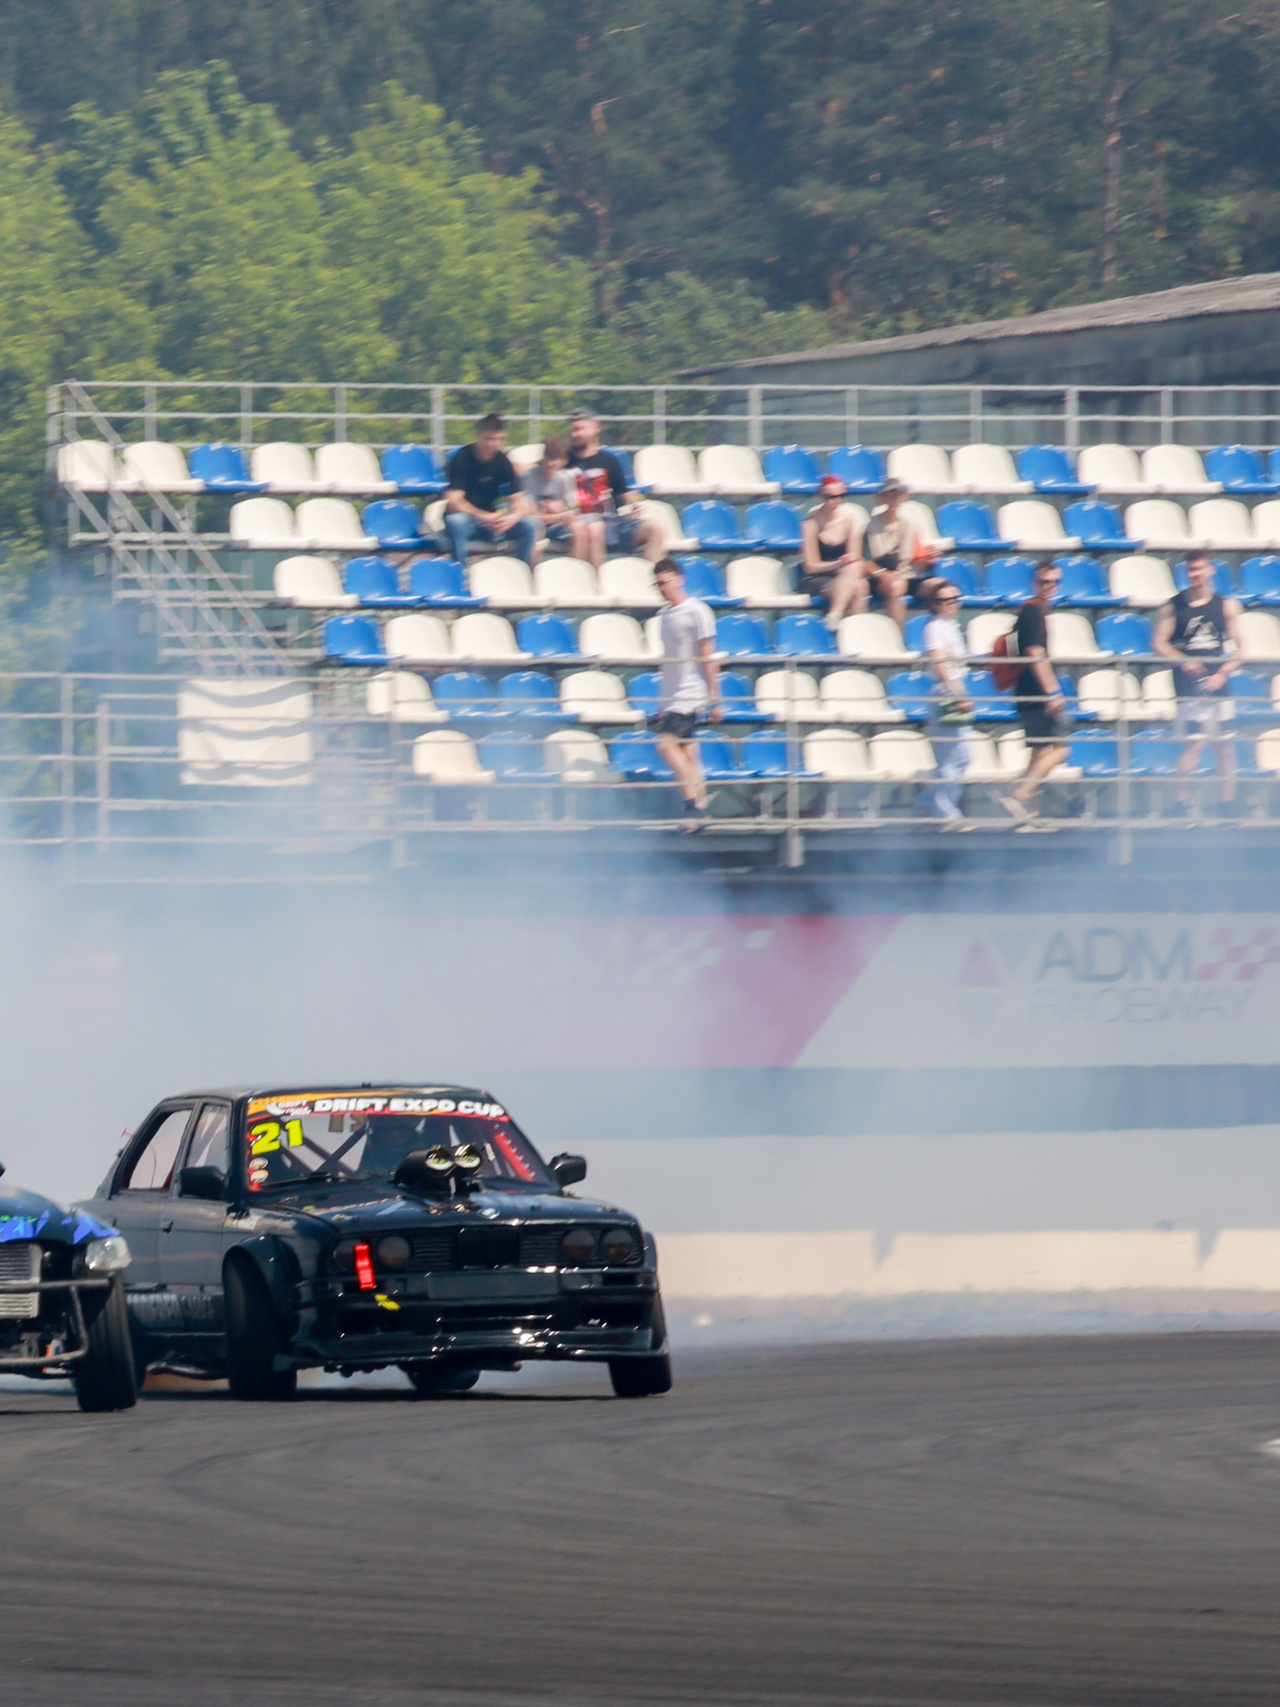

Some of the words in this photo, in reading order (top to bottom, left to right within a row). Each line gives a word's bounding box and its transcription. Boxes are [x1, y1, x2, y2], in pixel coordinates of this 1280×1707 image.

[1033, 926, 1192, 982] ADM
[314, 1098, 388, 1112] DRIFT
[389, 1098, 457, 1112] EXPO
[457, 1100, 505, 1118] CUP
[251, 1119, 305, 1155] 21
